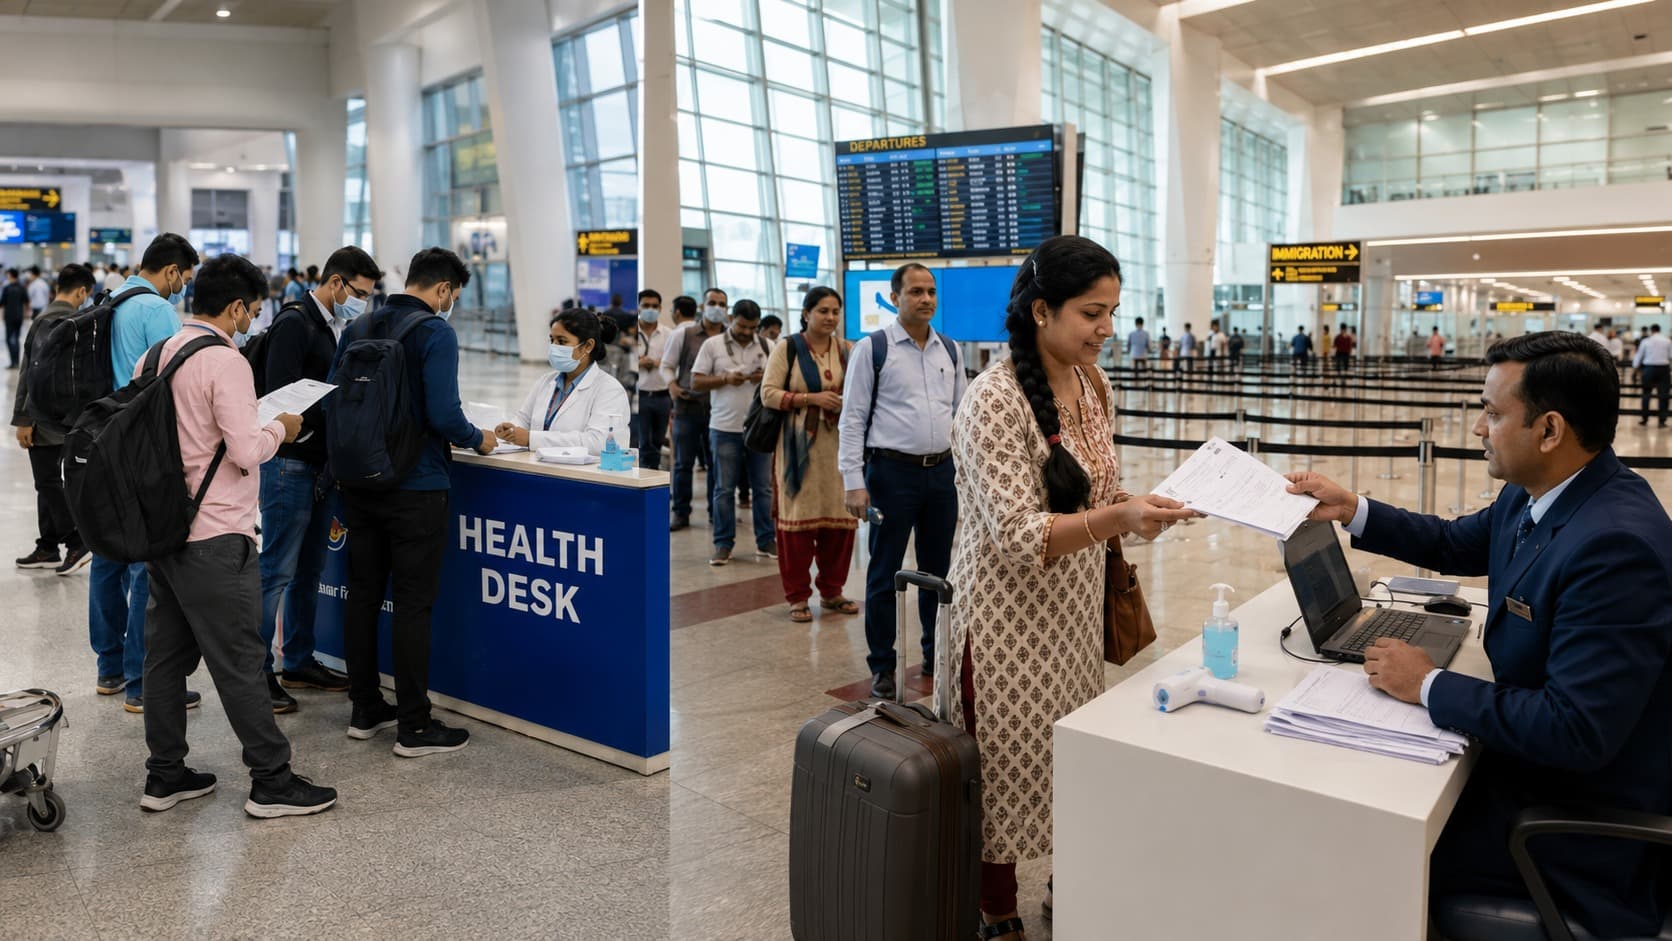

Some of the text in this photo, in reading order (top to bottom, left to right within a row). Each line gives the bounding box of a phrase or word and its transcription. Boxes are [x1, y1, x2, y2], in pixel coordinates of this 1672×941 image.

[849, 135, 927, 153] DEPARTURES
[1271, 245, 1344, 261] IMMIGRATION
[459, 514, 604, 576] HEALTH
[481, 567, 581, 624] DESK
